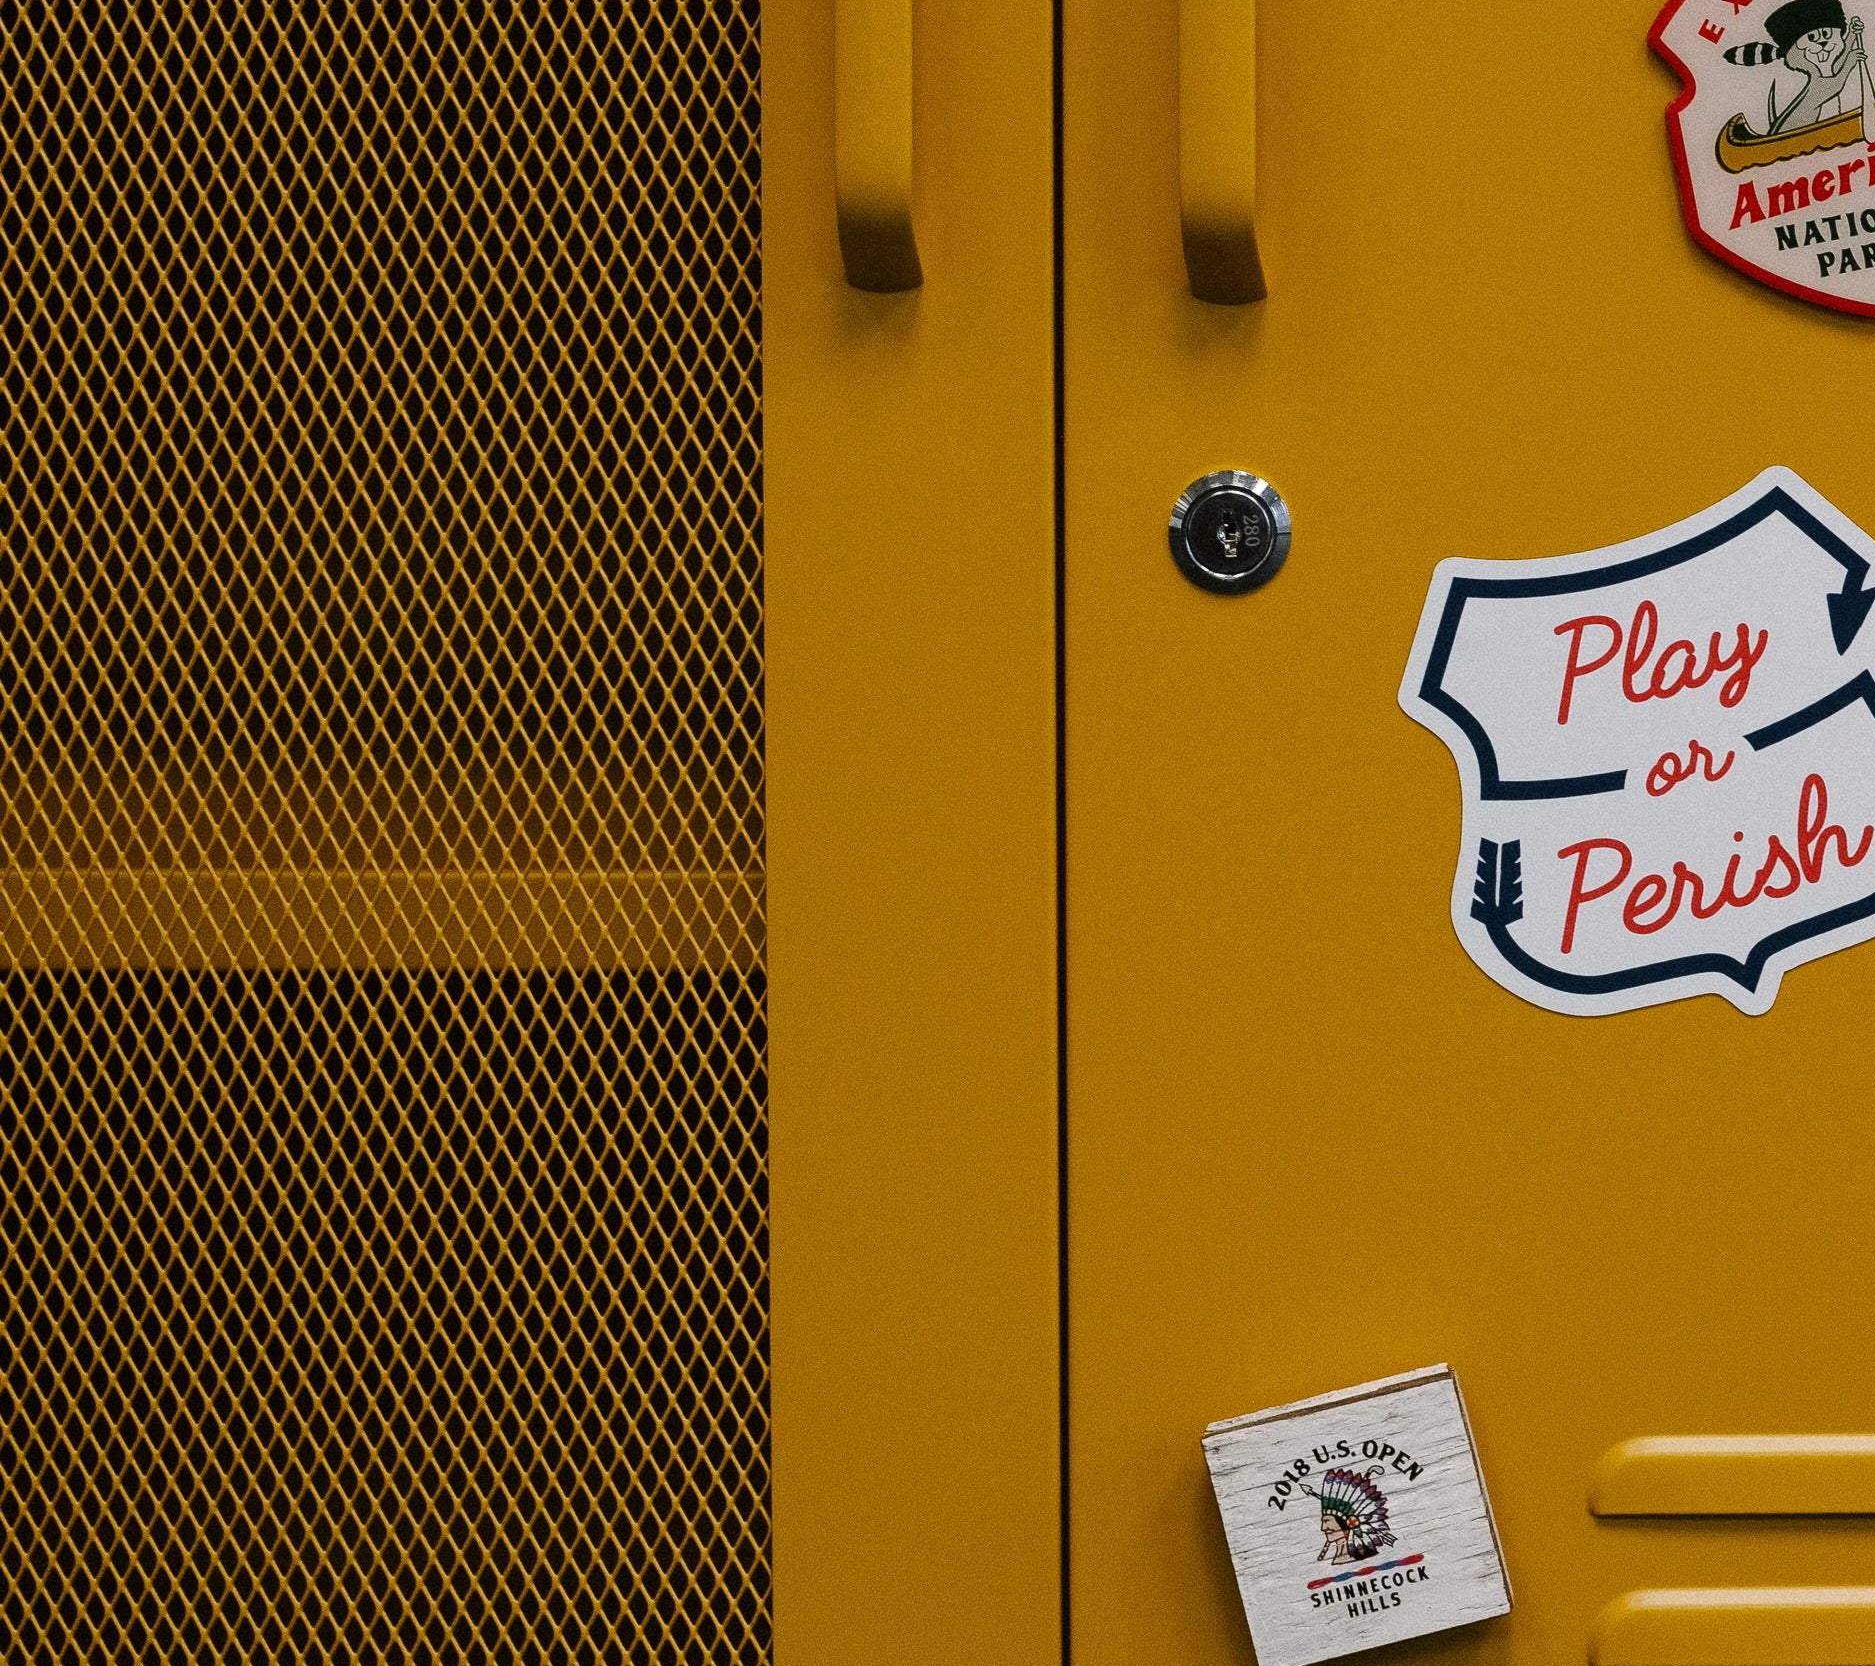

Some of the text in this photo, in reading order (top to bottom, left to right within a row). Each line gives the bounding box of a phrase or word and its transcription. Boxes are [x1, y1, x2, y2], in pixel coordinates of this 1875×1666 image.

[1243, 514, 1261, 547] 280
[1554, 600, 1769, 726] Play
[1646, 739, 1736, 797] or
[1557, 773, 1875, 955] Perish
[1267, 1439, 1425, 1512] 2018 U.S. OPEN
[1310, 1565, 1430, 1609] SHINNECOCK
[1346, 1591, 1402, 1619] HILLS
